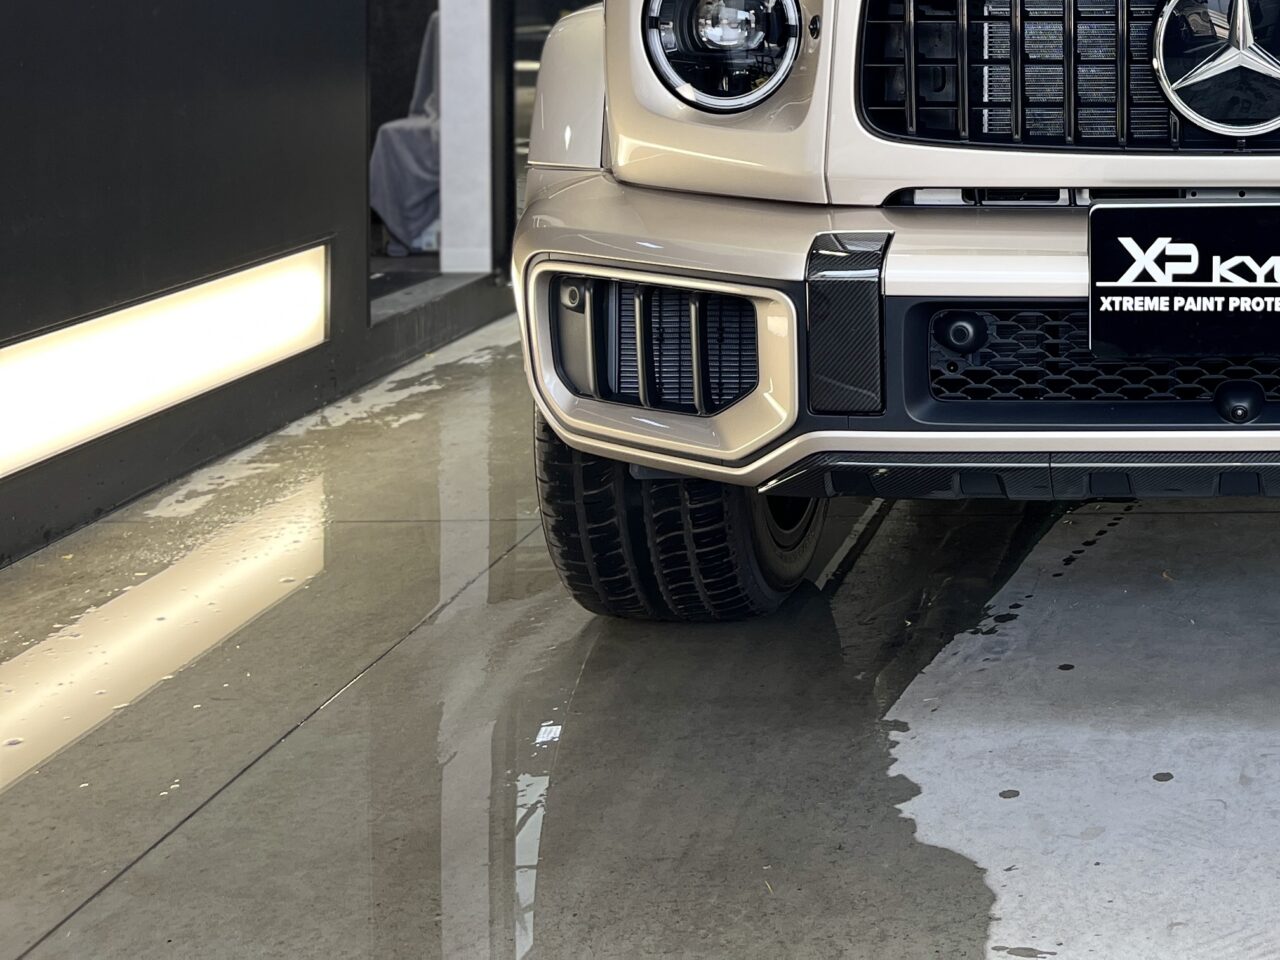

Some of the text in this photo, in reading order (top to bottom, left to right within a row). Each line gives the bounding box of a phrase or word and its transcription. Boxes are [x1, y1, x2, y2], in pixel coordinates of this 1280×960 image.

[1117, 236, 1199, 283] XP
[1099, 296, 1169, 312] XTREME
[1173, 296, 1225, 312] PAINT
